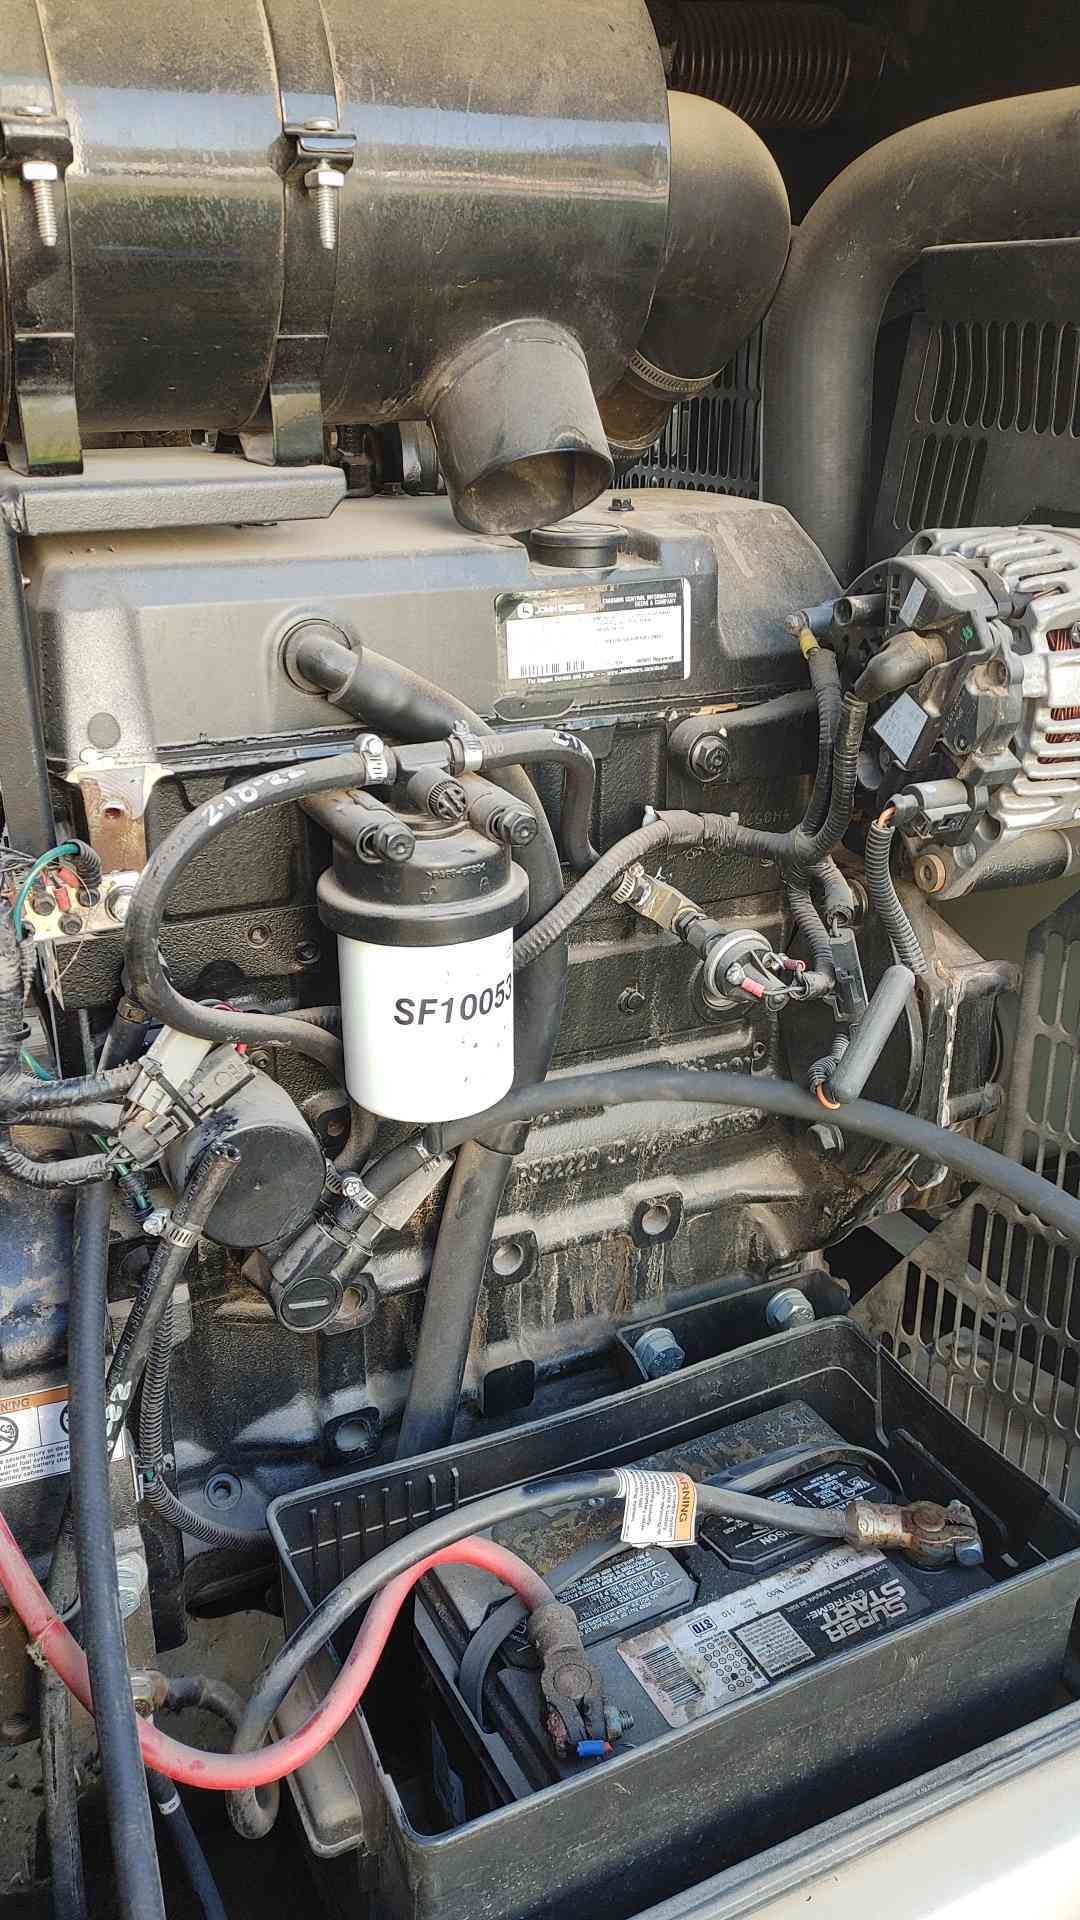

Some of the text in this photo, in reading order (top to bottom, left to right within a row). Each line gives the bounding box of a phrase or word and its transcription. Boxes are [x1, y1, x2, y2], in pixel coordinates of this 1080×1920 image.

[394, 973, 512, 1025] SF10053
[0, 1397, 30, 1412] NING
[691, 1617, 714, 1636] STD
[820, 1579, 906, 1631] START
[825, 1597, 907, 1642] SUPER
